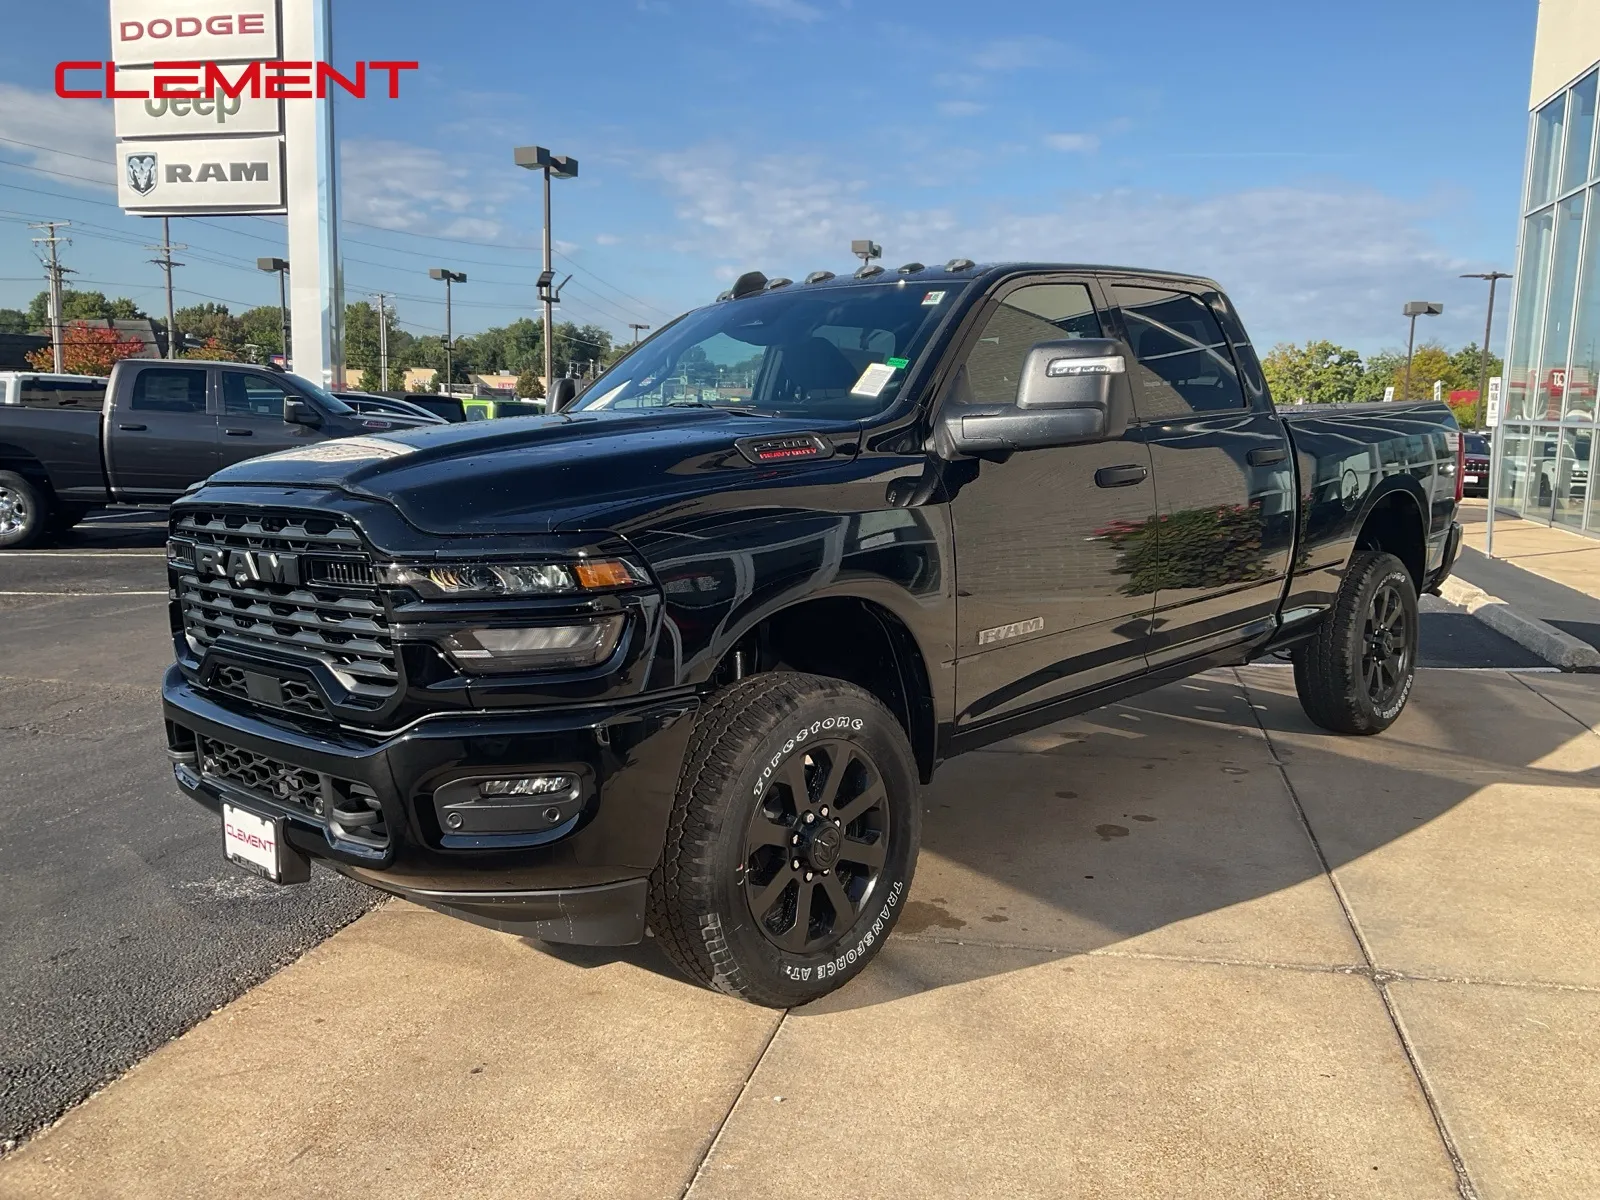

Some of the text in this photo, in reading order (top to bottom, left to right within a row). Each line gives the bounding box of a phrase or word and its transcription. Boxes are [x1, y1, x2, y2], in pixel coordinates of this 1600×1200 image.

[120, 13, 265, 42] DODGE
[144, 78, 241, 123] Jeep
[164, 162, 269, 183] RAM
[759, 447, 817, 459] HEAVY DUTY
[195, 545, 300, 586] RAM
[983, 619, 1041, 642] RAM
[226, 823, 276, 853] CLEMENT
[817, 881, 903, 979] TRANSFORCE
